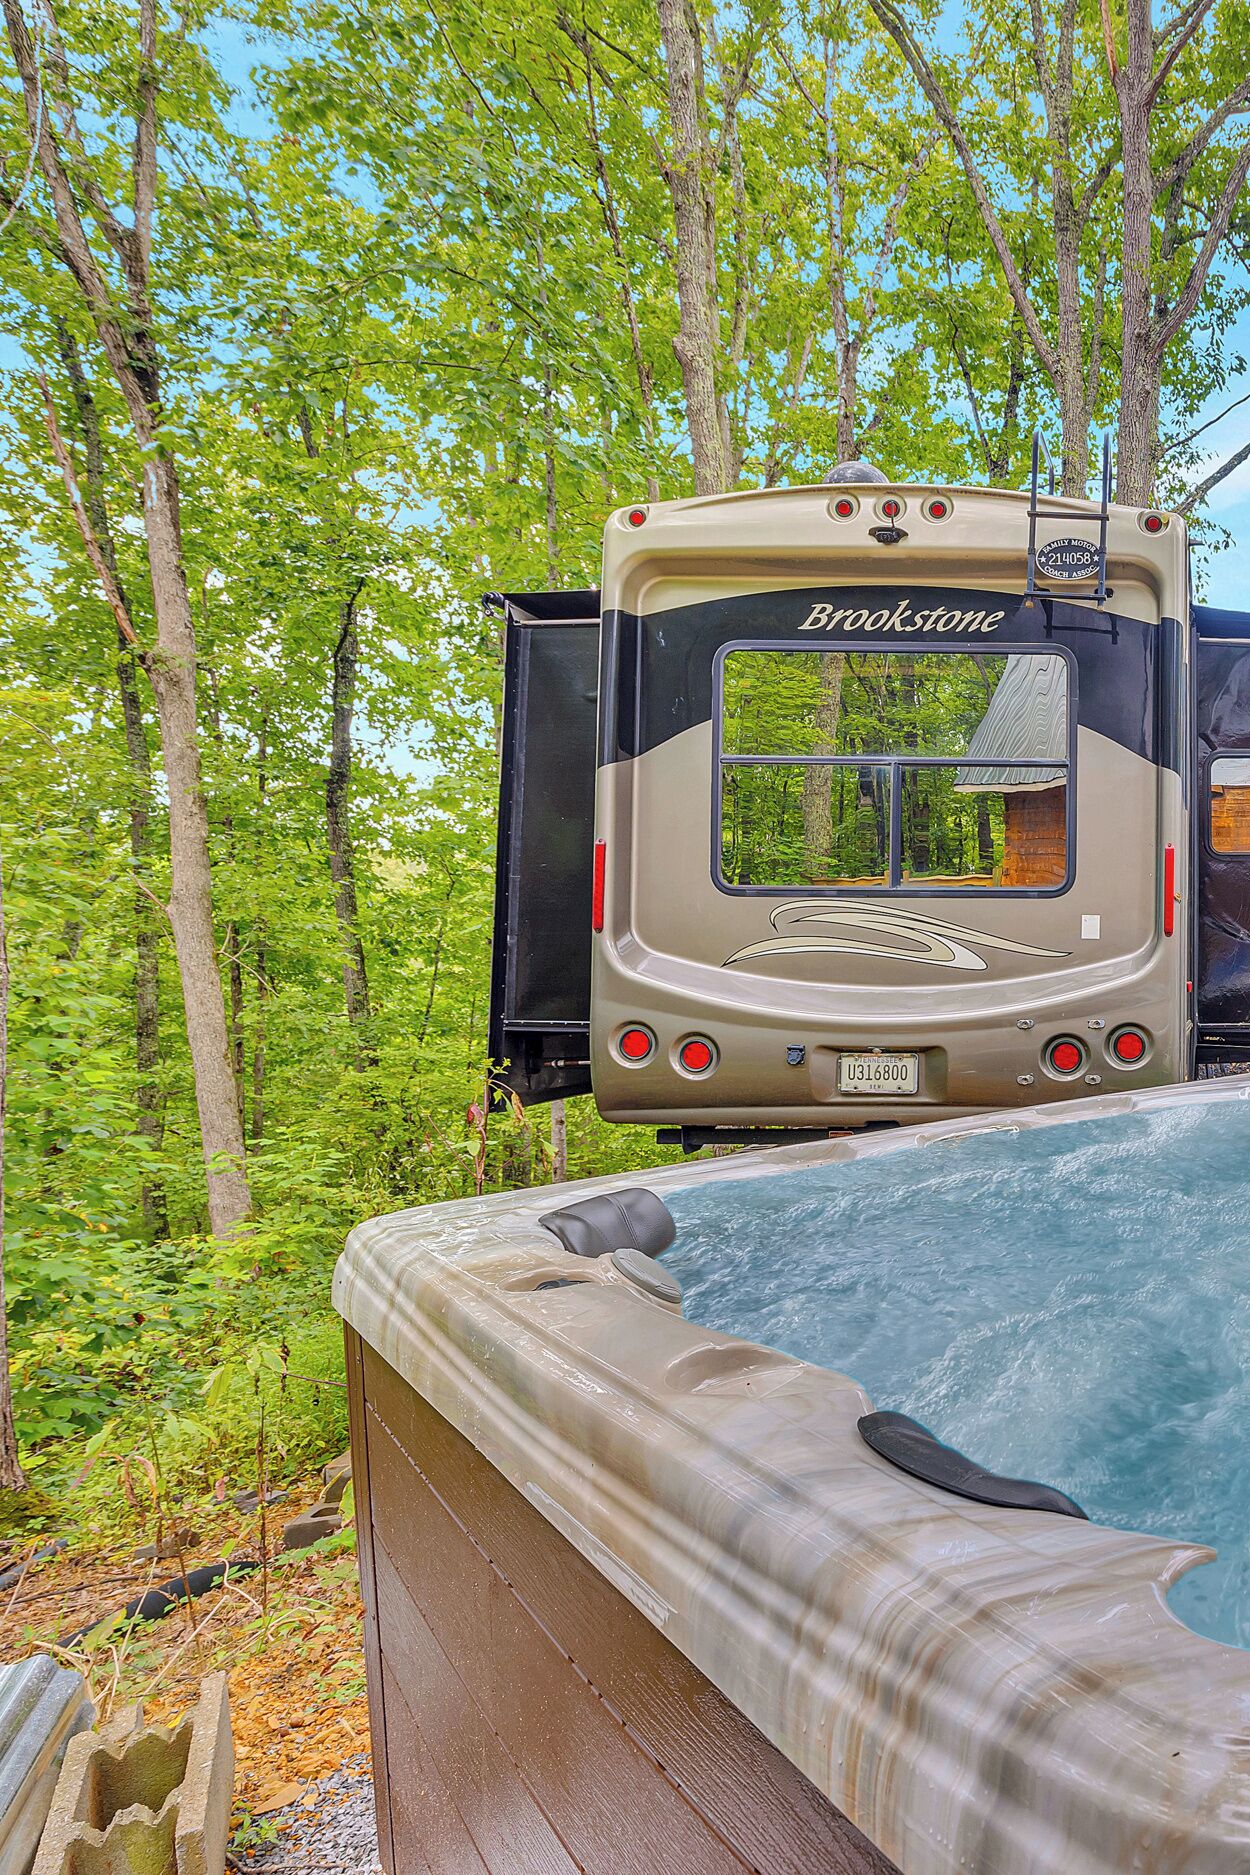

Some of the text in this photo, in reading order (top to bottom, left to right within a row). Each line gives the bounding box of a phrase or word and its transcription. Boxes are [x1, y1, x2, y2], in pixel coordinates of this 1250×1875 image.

[1042, 539, 1097, 554] FAMILY MOTOR
[1048, 552, 1091, 565] 214058
[1044, 565, 1069, 578] COACH
[797, 599, 1005, 633] Brookstone
[848, 1064, 908, 1080] U316800
